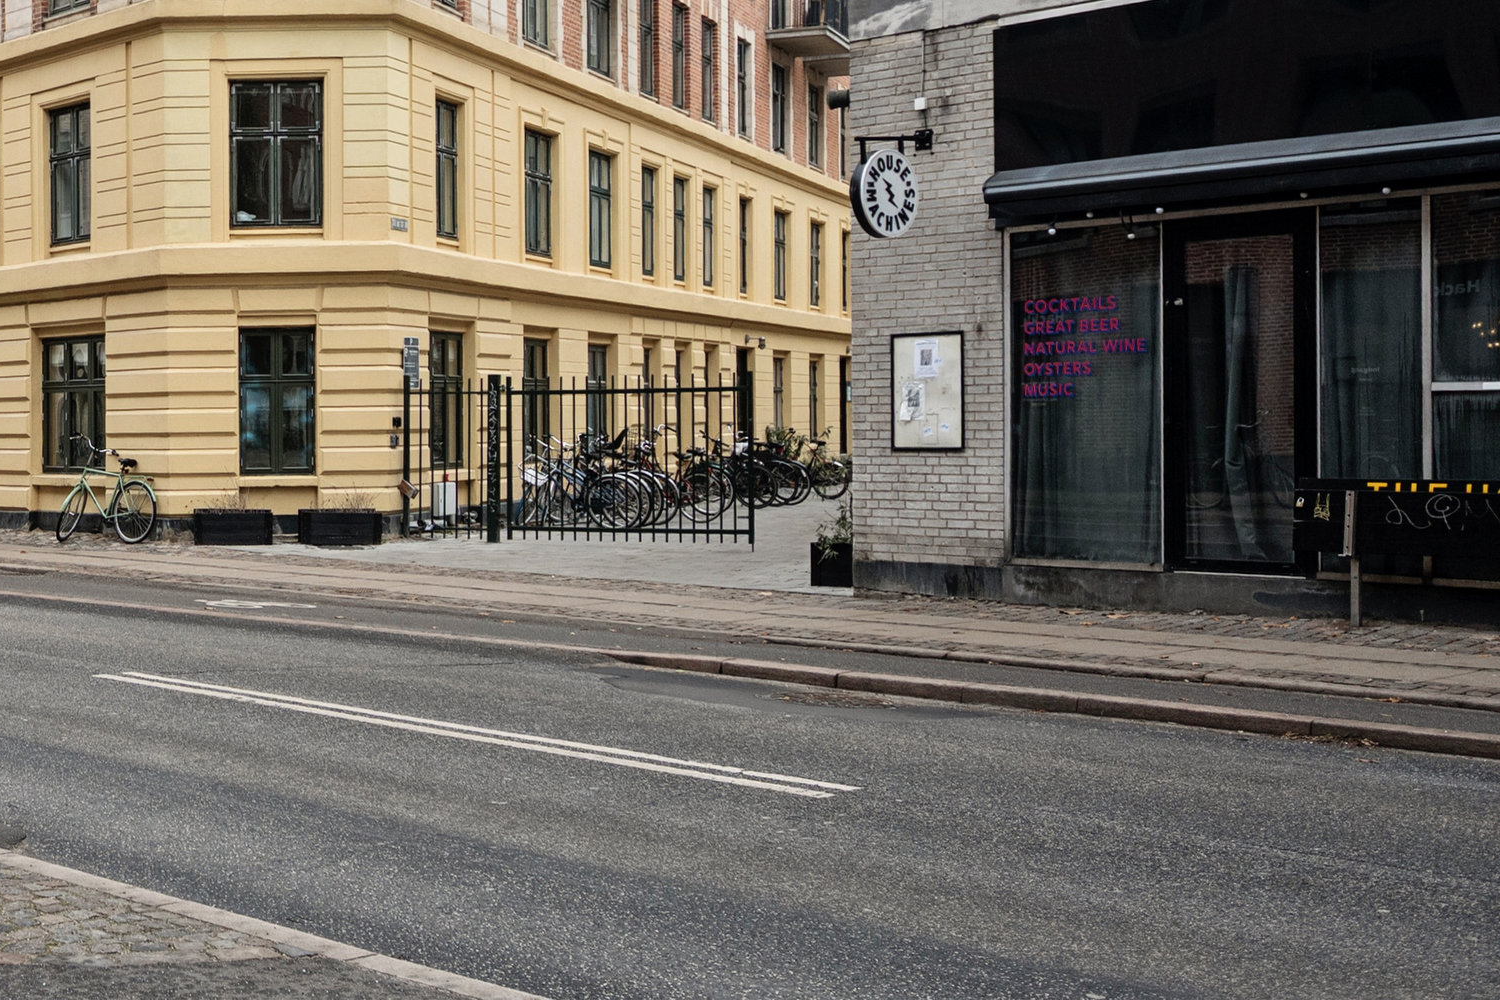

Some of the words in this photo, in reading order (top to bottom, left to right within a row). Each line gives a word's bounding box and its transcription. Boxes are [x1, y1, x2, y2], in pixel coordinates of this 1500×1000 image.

[869, 155, 911, 182] HOUSE
[866, 188, 915, 232] MACHINES
[1024, 296, 1118, 314] COCKTAILS
[1024, 319, 1075, 335] GREAT
[1080, 317, 1120, 333] BEER
[1024, 341, 1098, 356] NATURAL
[1102, 338, 1147, 353] WINE
[1023, 361, 1093, 376] OYSTERS
[1024, 382, 1075, 397] MUSIC
